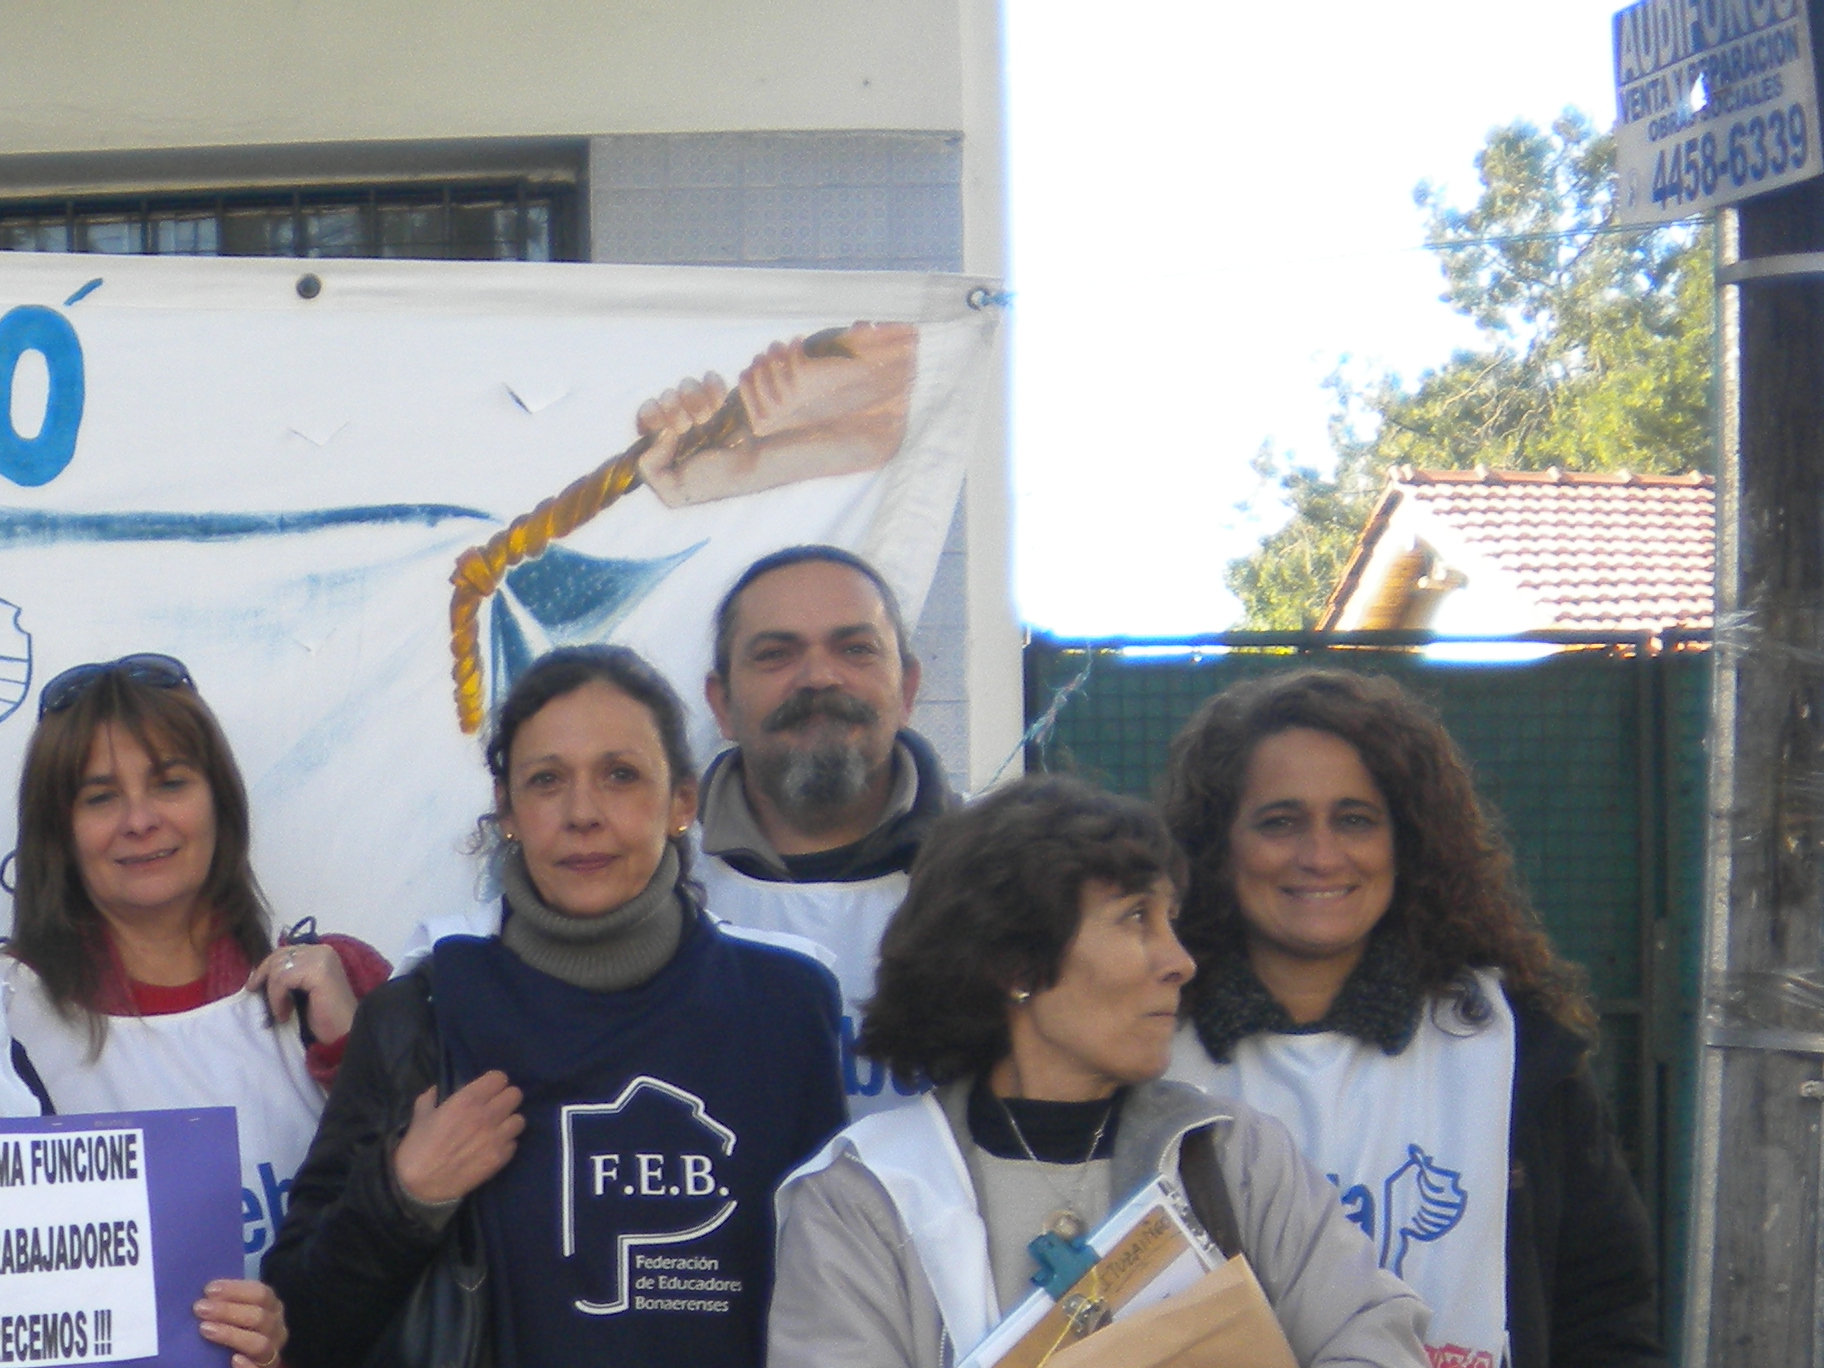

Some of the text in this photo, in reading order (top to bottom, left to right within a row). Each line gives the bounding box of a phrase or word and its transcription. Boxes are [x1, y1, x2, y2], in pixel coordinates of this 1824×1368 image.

[1620, 0, 1797, 83] AUDIFON
[1651, 102, 1808, 211] 4458-6339
[31, 1133, 139, 1185] FUNCIONE
[589, 1152, 731, 1197] F.E.B.
[634, 1254, 720, 1271] Federación
[634, 1274, 743, 1293] de Educadores
[634, 1295, 730, 1313] Bonaerenses
